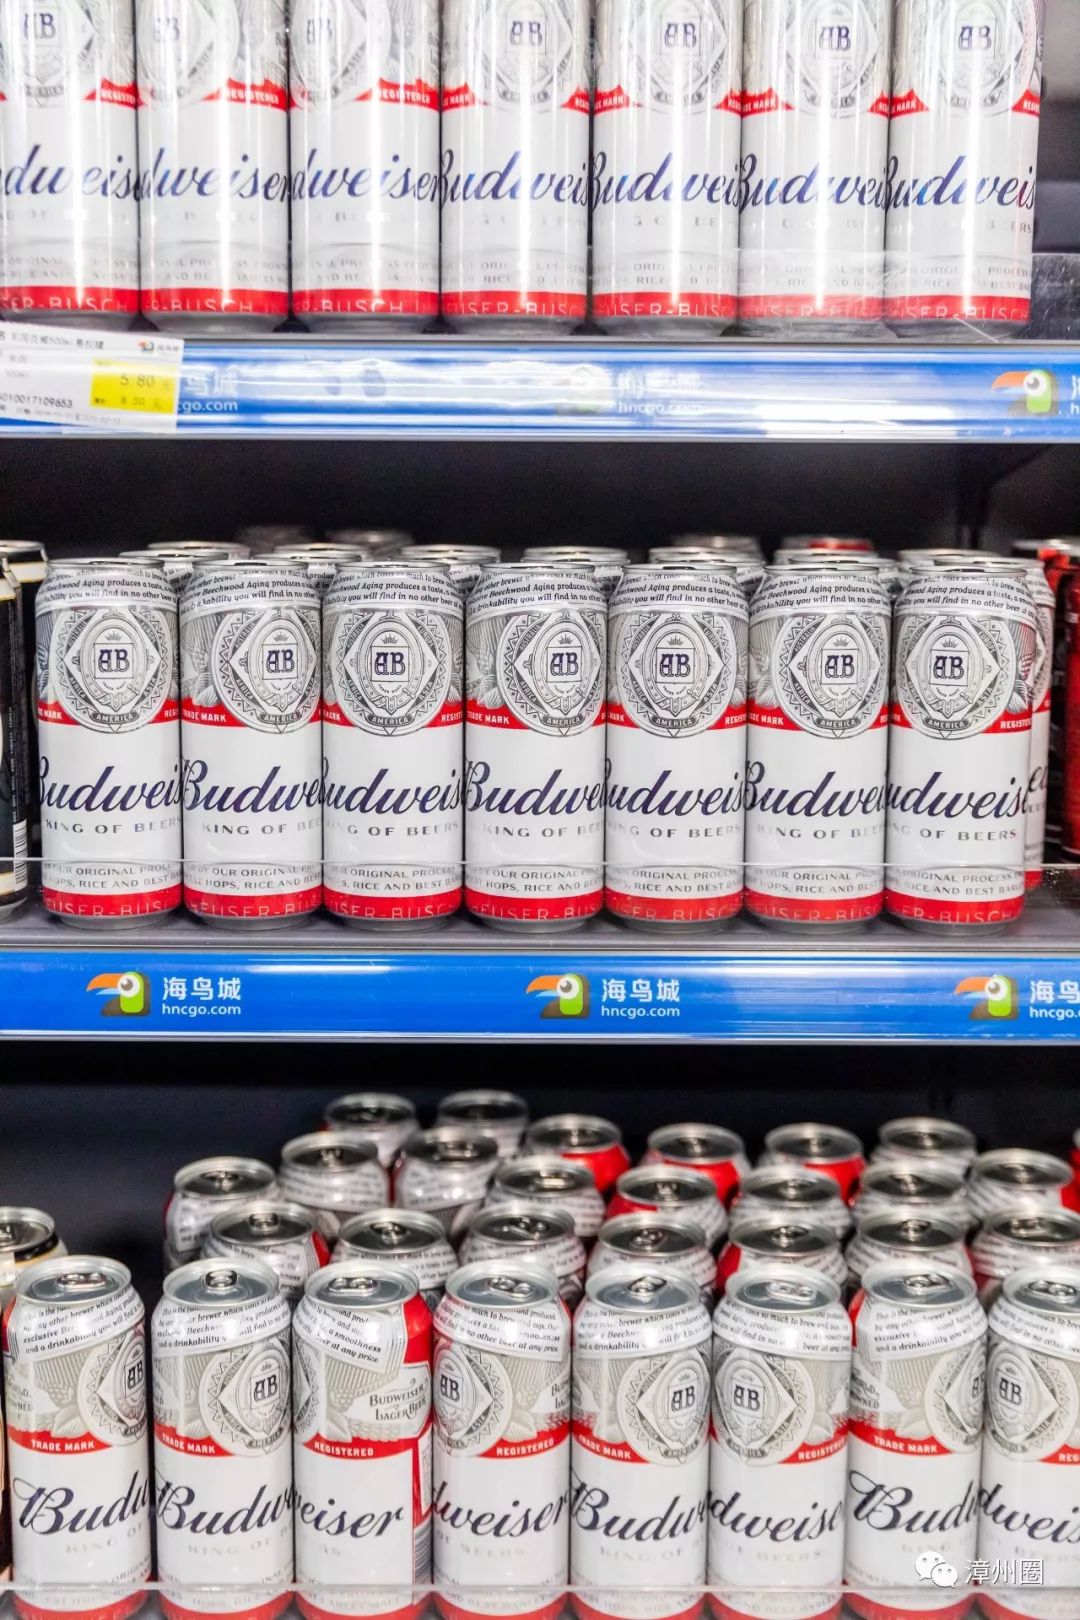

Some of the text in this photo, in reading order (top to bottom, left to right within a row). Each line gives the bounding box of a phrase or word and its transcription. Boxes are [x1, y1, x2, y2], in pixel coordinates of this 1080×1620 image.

[108, 579, 141, 587] produces
[672, 584, 706, 592] produces
[949, 586, 984, 595] produces
[941, 596, 958, 604] find
[984, 600, 1004, 608] other
[98, 648, 128, 673] AB
[266, 650, 295, 674] AB
[374, 651, 405, 676] AB
[550, 652, 579, 676] AB
[659, 653, 690, 677] AB
[824, 654, 855, 678] AB
[933, 655, 964, 679] AB
[201, 712, 226, 722] MARK
[485, 713, 510, 724] MARK
[761, 715, 784, 726] MARK
[655, 718, 693, 728] AMERICA
[95, 824, 122, 834] OF
[262, 824, 286, 834] OF
[368, 821, 458, 836] OF BEERS
[542, 828, 568, 837] OF
[650, 828, 676, 838] OF
[814, 829, 840, 839] OF
[920, 828, 1016, 840] OF BEERS
[76, 868, 135, 876] ORIGINAL
[350, 868, 408, 878] ORIGINAL
[521, 871, 578, 879] ORIGINAL
[632, 870, 689, 880] ORIGINAL
[793, 872, 850, 880] ORIGINAL
[244, 881, 273, 889] RICE
[352, 882, 380, 890] RICE
[524, 884, 553, 892] RICE
[634, 882, 661, 891] RICE
[796, 885, 824, 893] RICE
[933, 885, 960, 895] AND
[162, 977, 241, 1001] 海鸟城
[601, 978, 681, 1003] 海鸟城
[162, 1003, 241, 1017] hncgo.com
[601, 1005, 681, 1018] hncgo.com
[24, 1331, 58, 1343] exclusive
[341, 1347, 357, 1357] any
[254, 1374, 279, 1402] AB
[671, 1385, 696, 1412] AB
[31, 1439, 95, 1451] TRADE MARK
[187, 1442, 215, 1454] MARK
[314, 1442, 374, 1457] REGISTERED
[496, 1439, 554, 1456] REGISTERED
[908, 1442, 937, 1453] MARK
[603, 1446, 631, 1460] MARK
